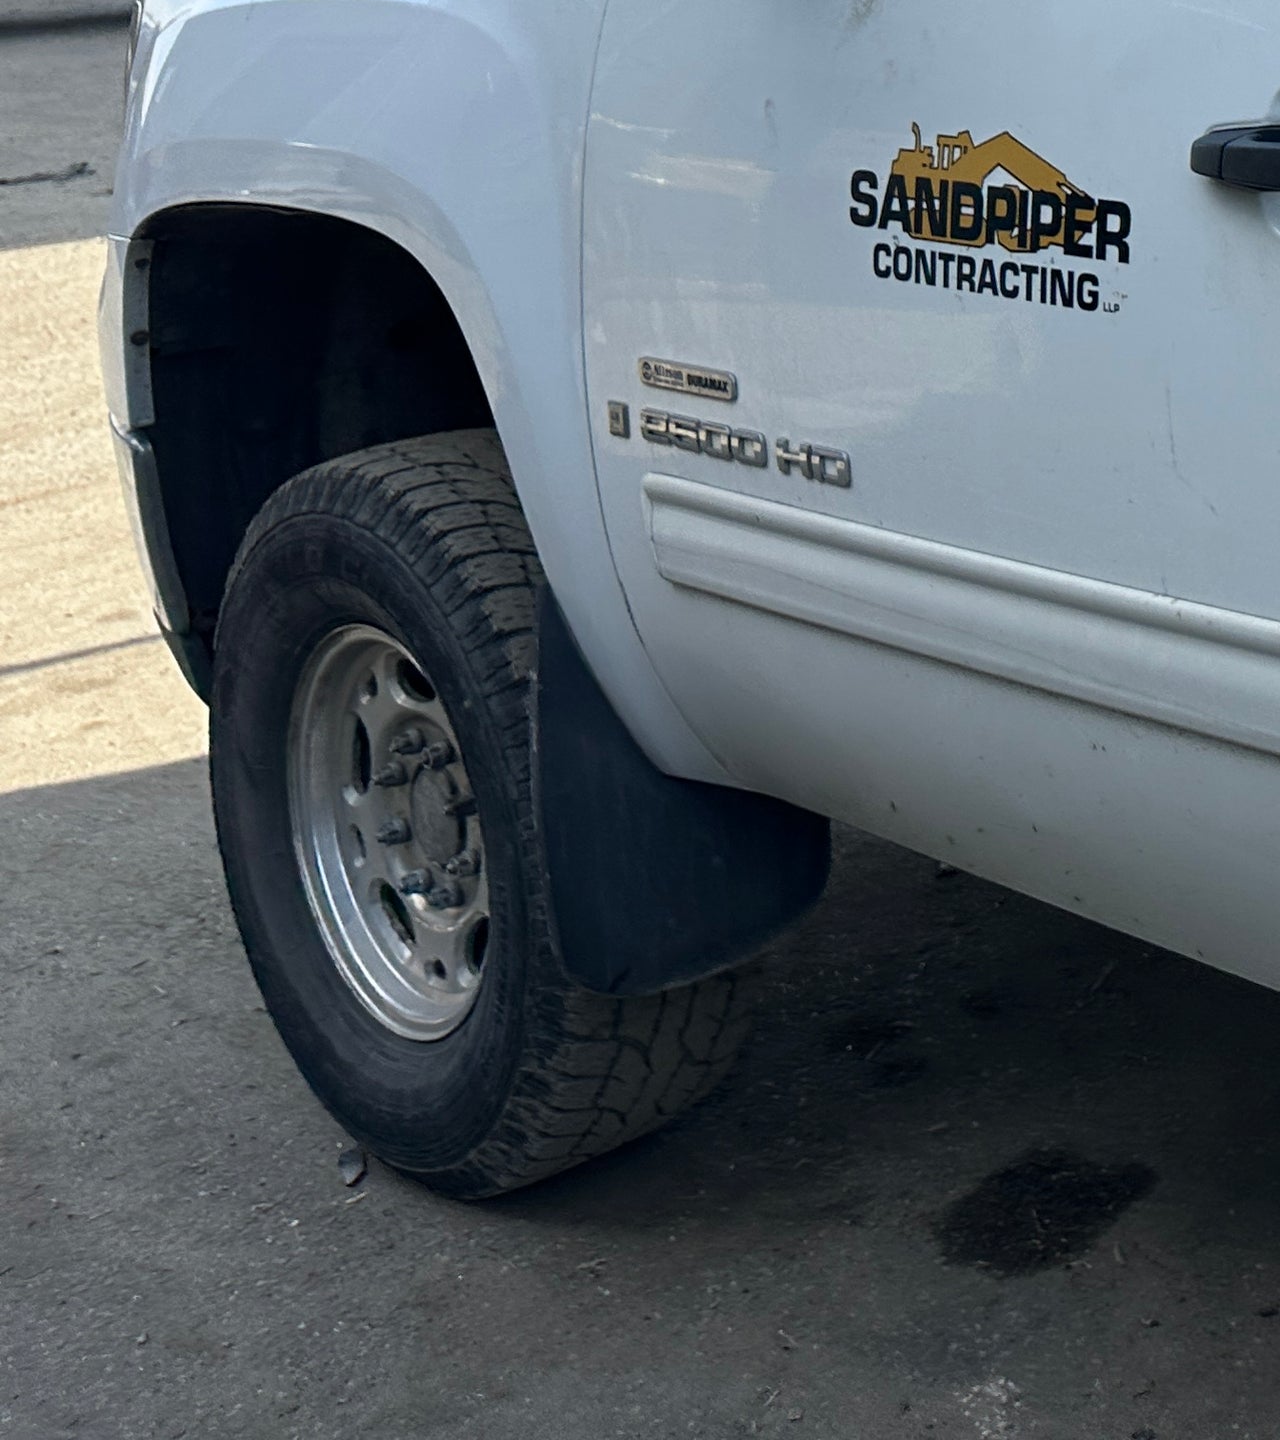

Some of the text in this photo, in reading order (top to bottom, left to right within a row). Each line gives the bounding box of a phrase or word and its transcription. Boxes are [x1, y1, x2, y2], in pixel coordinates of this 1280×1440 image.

[849, 169, 1132, 265] SANDPIPER
[873, 242, 1100, 313] CONTRACTING
[640, 407, 768, 469] 2500
